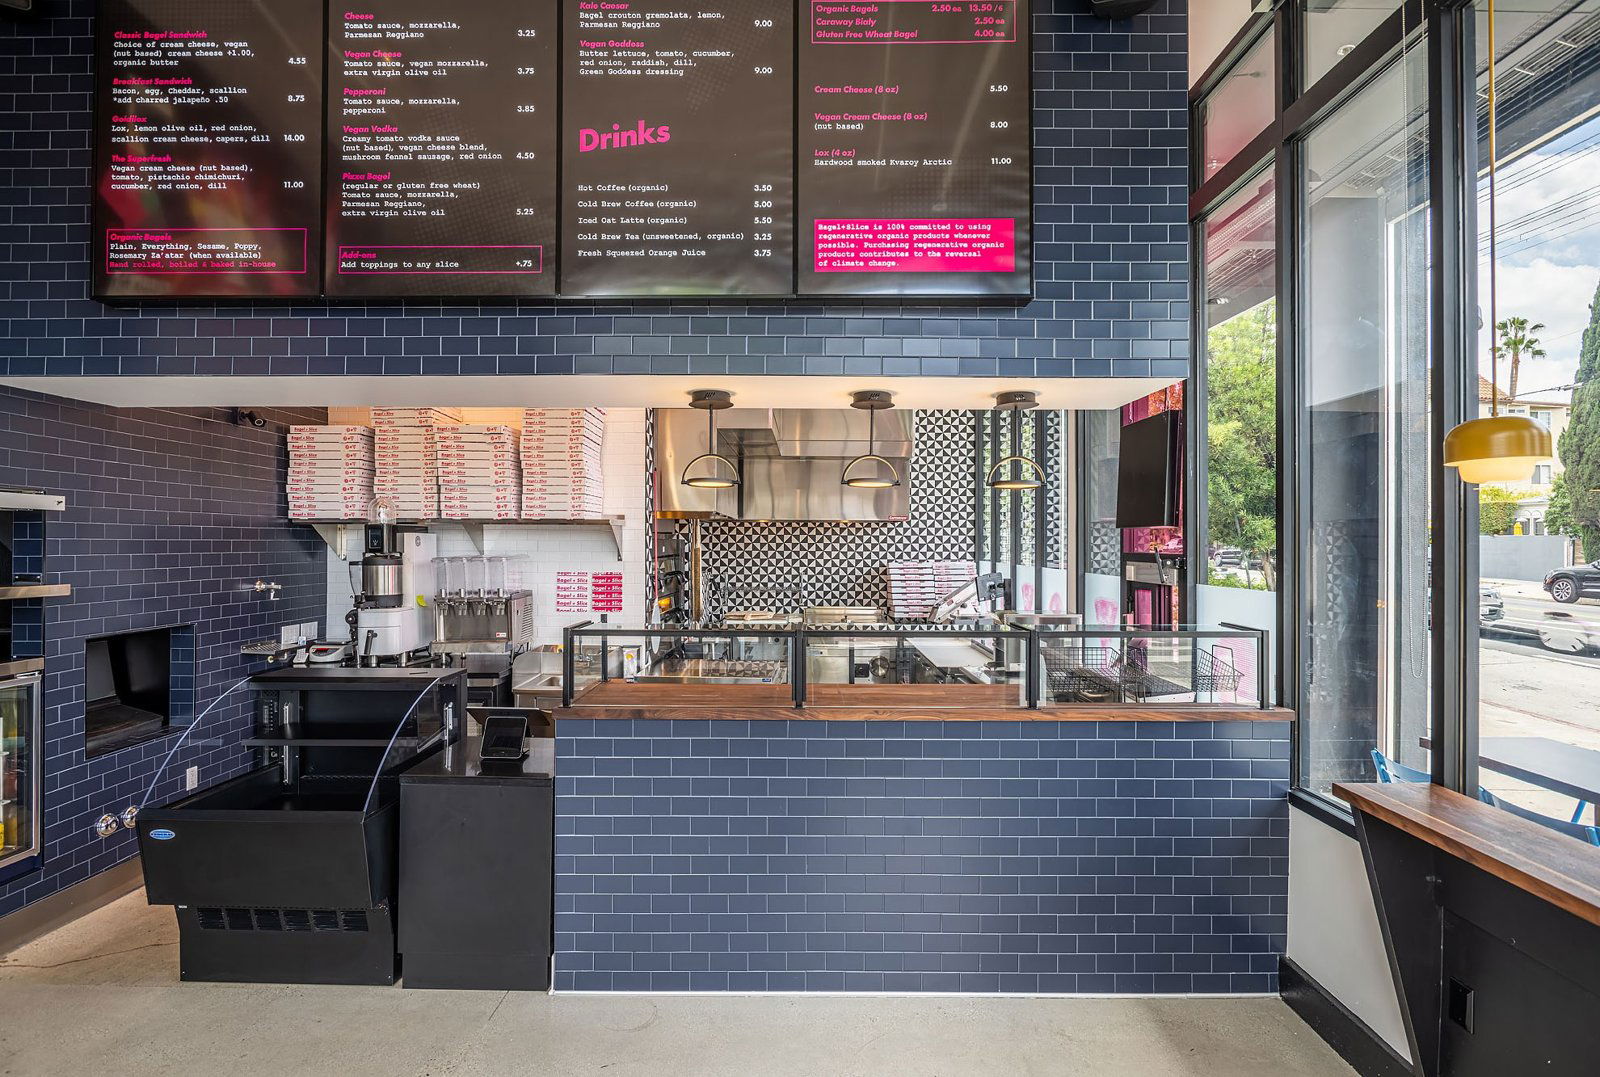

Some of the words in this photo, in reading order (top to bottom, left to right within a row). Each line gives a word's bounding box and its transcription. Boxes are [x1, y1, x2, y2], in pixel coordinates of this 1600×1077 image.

[579, 2, 599, 10] Kale
[600, 2, 629, 10] Caesar
[816, 5, 849, 14] Organic
[850, 5, 879, 14] Bagels
[932, 4, 951, 13] 2.50
[969, 4, 993, 12] 13.50
[344, 12, 374, 20] Cheese
[580, 12, 603, 20] Bagel
[645, 12, 692, 20] gremolata,
[697, 11, 725, 19] lemon,
[816, 18, 853, 27] Caraway
[975, 16, 994, 25] 2.50
[409, 21, 460, 29] mozzarella,
[143, 32, 170, 40] Bagel
[386, 31, 424, 39] Reggiano
[518, 29, 535, 37] 3.25
[580, 40, 607, 49] Vegan
[607, 40, 645, 48] Goddess
[344, 51, 371, 59] Vegan
[372, 50, 401, 58] Cheese
[613, 50, 649, 58] lettuce,
[655, 50, 687, 58] tomato,
[113, 59, 146, 67] organic
[372, 69, 401, 77] virgin
[517, 67, 535, 75] 3.75
[144, 88, 163, 96] egg,
[168, 87, 204, 95] Cheddar,
[343, 87, 386, 97] Pepperoni
[343, 107, 386, 115] pepperoni
[815, 113, 842, 122] Vegan
[843, 113, 870, 121] Cream
[871, 113, 902, 121] Cheese
[903, 112, 913, 121] (8
[913, 113, 928, 121] oz)
[343, 126, 369, 134] Vegan
[814, 123, 832, 131] (nut
[836, 123, 864, 131] based)
[284, 134, 305, 142] 14.00
[342, 135, 371, 143] Creamy
[579, 120, 671, 152] Drinks
[112, 154, 126, 162] The
[148, 174, 191, 182] pistachio
[628, 184, 668, 192] (organic)
[754, 184, 772, 192] 3.50
[754, 200, 772, 208] 5.00
[647, 217, 687, 225] (organic)
[754, 233, 772, 241] 3.25
[142, 243, 192, 251] Everything,
[234, 242, 261, 251] Poppy,
[818, 242, 858, 250] possible.
[914, 241, 968, 249] regenerative
[972, 241, 1004, 249] organic
[340, 250, 376, 258] Add-ons
[606, 249, 645, 258] Squeezed
[648, 249, 677, 258] Orange
[754, 249, 772, 257] 3.75
[360, 261, 398, 269] toppings
